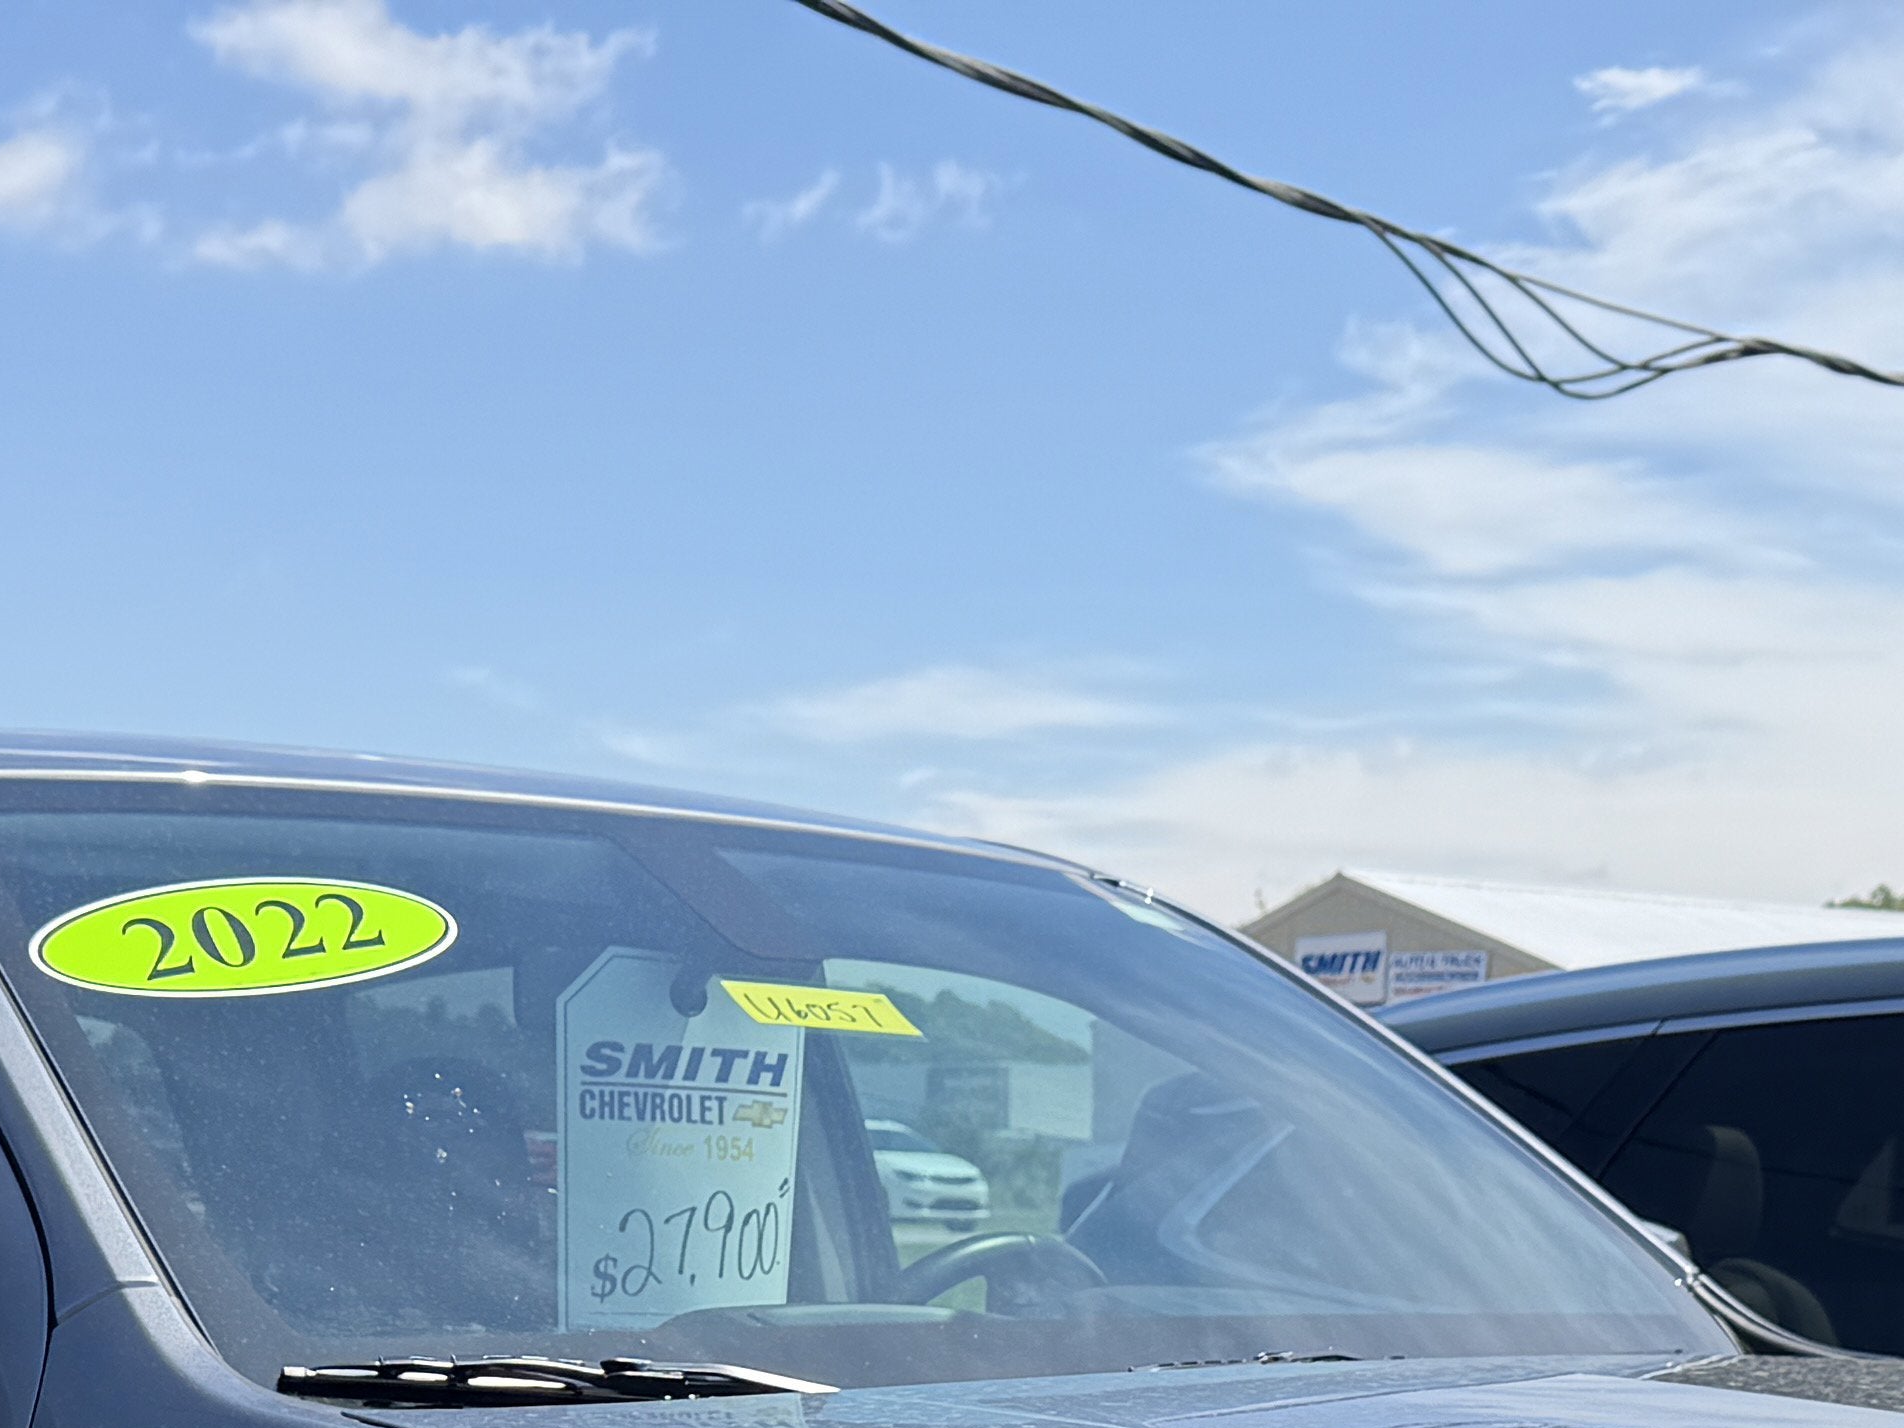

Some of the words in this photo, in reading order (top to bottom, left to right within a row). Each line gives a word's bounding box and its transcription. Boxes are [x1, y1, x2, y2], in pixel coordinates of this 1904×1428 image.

[122, 893, 386, 981] 2022
[1301, 951, 1382, 975] SMITH
[744, 992, 883, 1028] U6057
[580, 1041, 789, 1088] SMITH
[579, 1088, 728, 1126] CHEVROLET
[626, 1127, 697, 1158] Since
[703, 1134, 756, 1162] 1954
